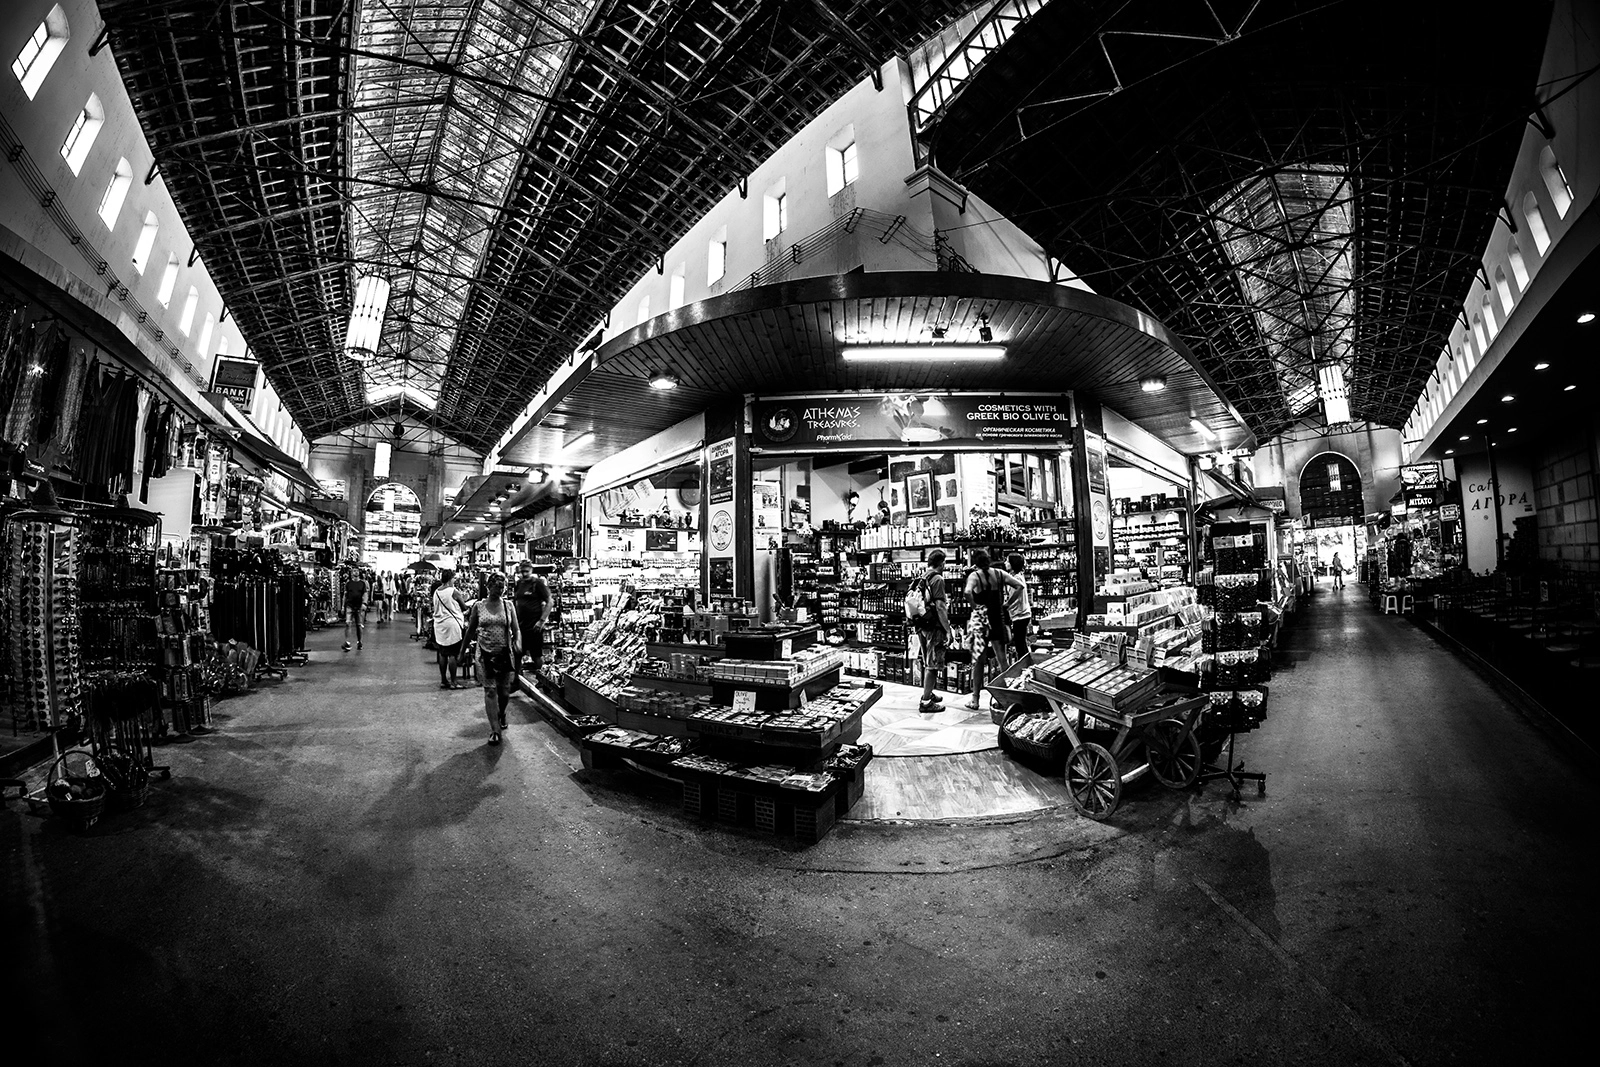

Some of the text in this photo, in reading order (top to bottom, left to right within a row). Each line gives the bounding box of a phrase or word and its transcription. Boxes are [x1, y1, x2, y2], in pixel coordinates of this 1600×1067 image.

[215, 386, 245, 397] BANK
[803, 406, 861, 420] ATHENA'S
[978, 404, 1031, 412] COSMETICS
[966, 412, 1069, 421] GREEK BIO OLIVE OIL
